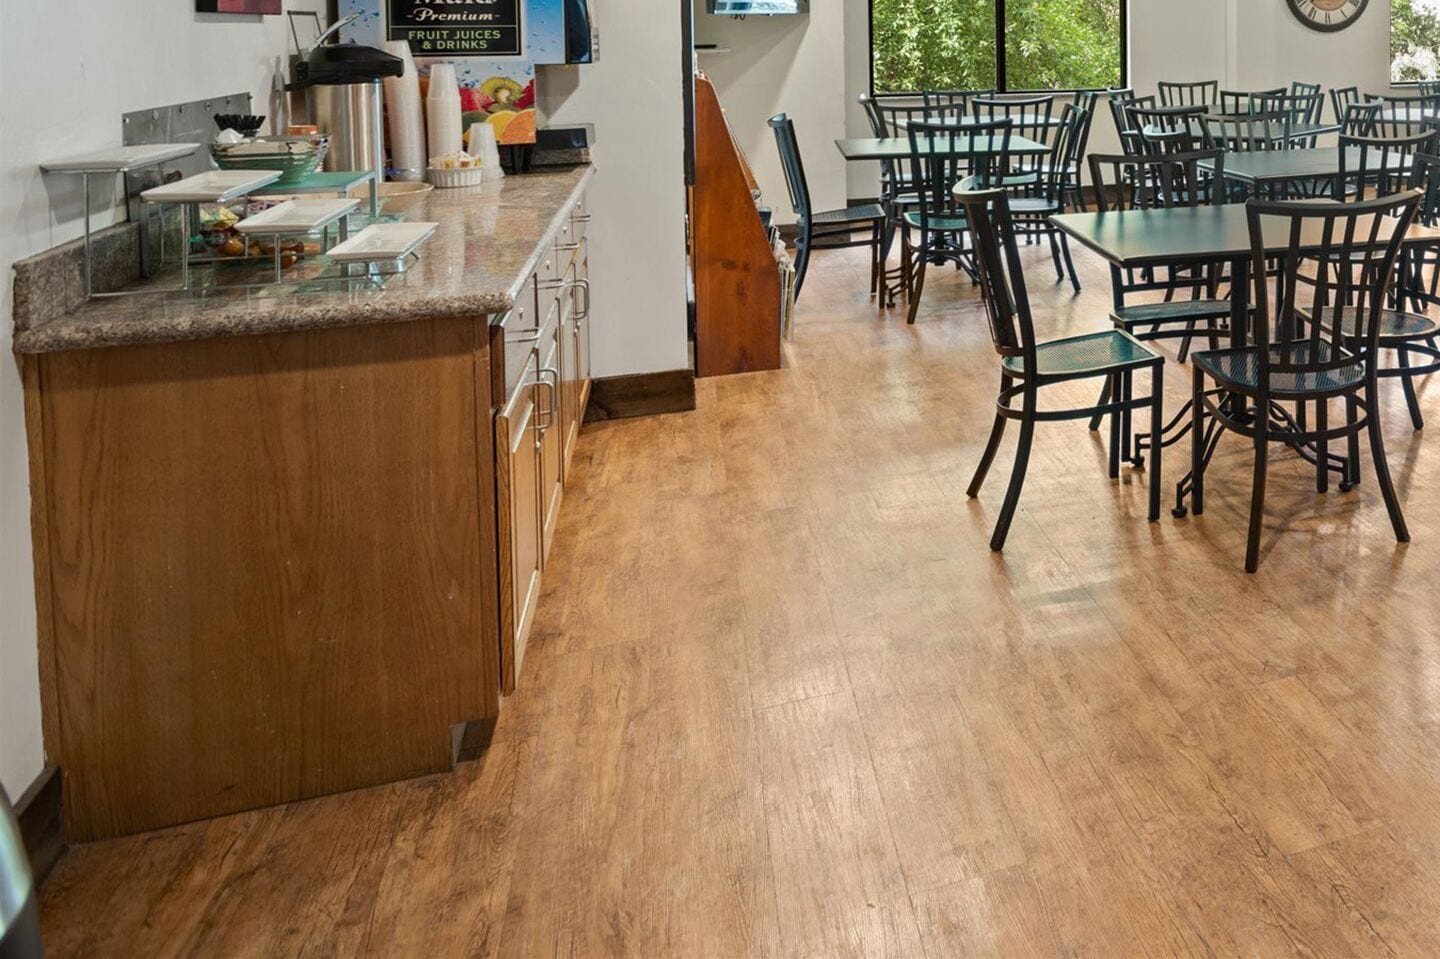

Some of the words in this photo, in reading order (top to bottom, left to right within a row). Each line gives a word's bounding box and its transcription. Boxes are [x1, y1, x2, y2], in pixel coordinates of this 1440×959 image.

[408, 30, 449, 40] FRUIT
[453, 30, 502, 39] JUICES
[422, 41, 432, 49] &
[437, 41, 488, 50] DRINKS
